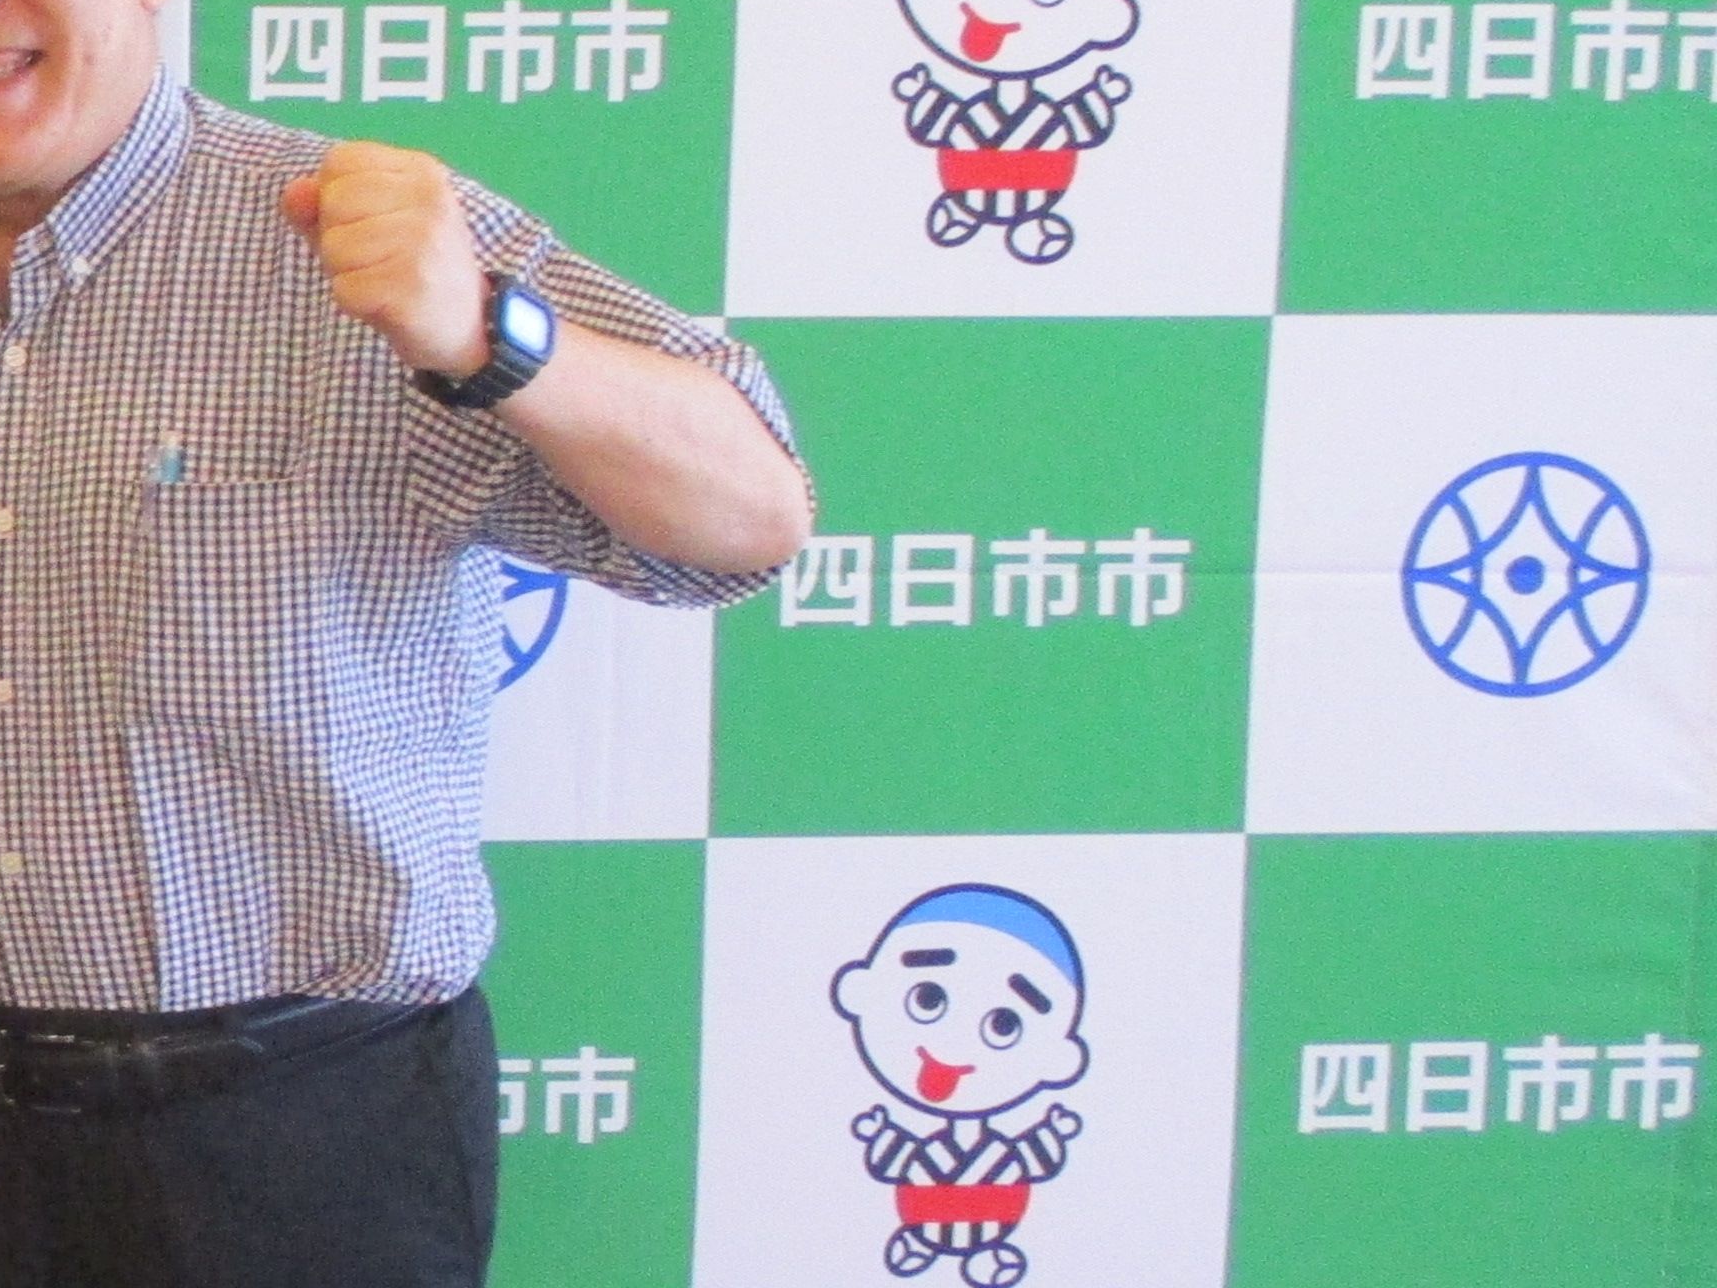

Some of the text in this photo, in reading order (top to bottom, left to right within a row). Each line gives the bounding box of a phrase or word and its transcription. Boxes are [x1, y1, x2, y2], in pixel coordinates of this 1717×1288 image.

[780, 527, 1192, 627] 四日市市
[1298, 1033, 1702, 1134] 四日市市
